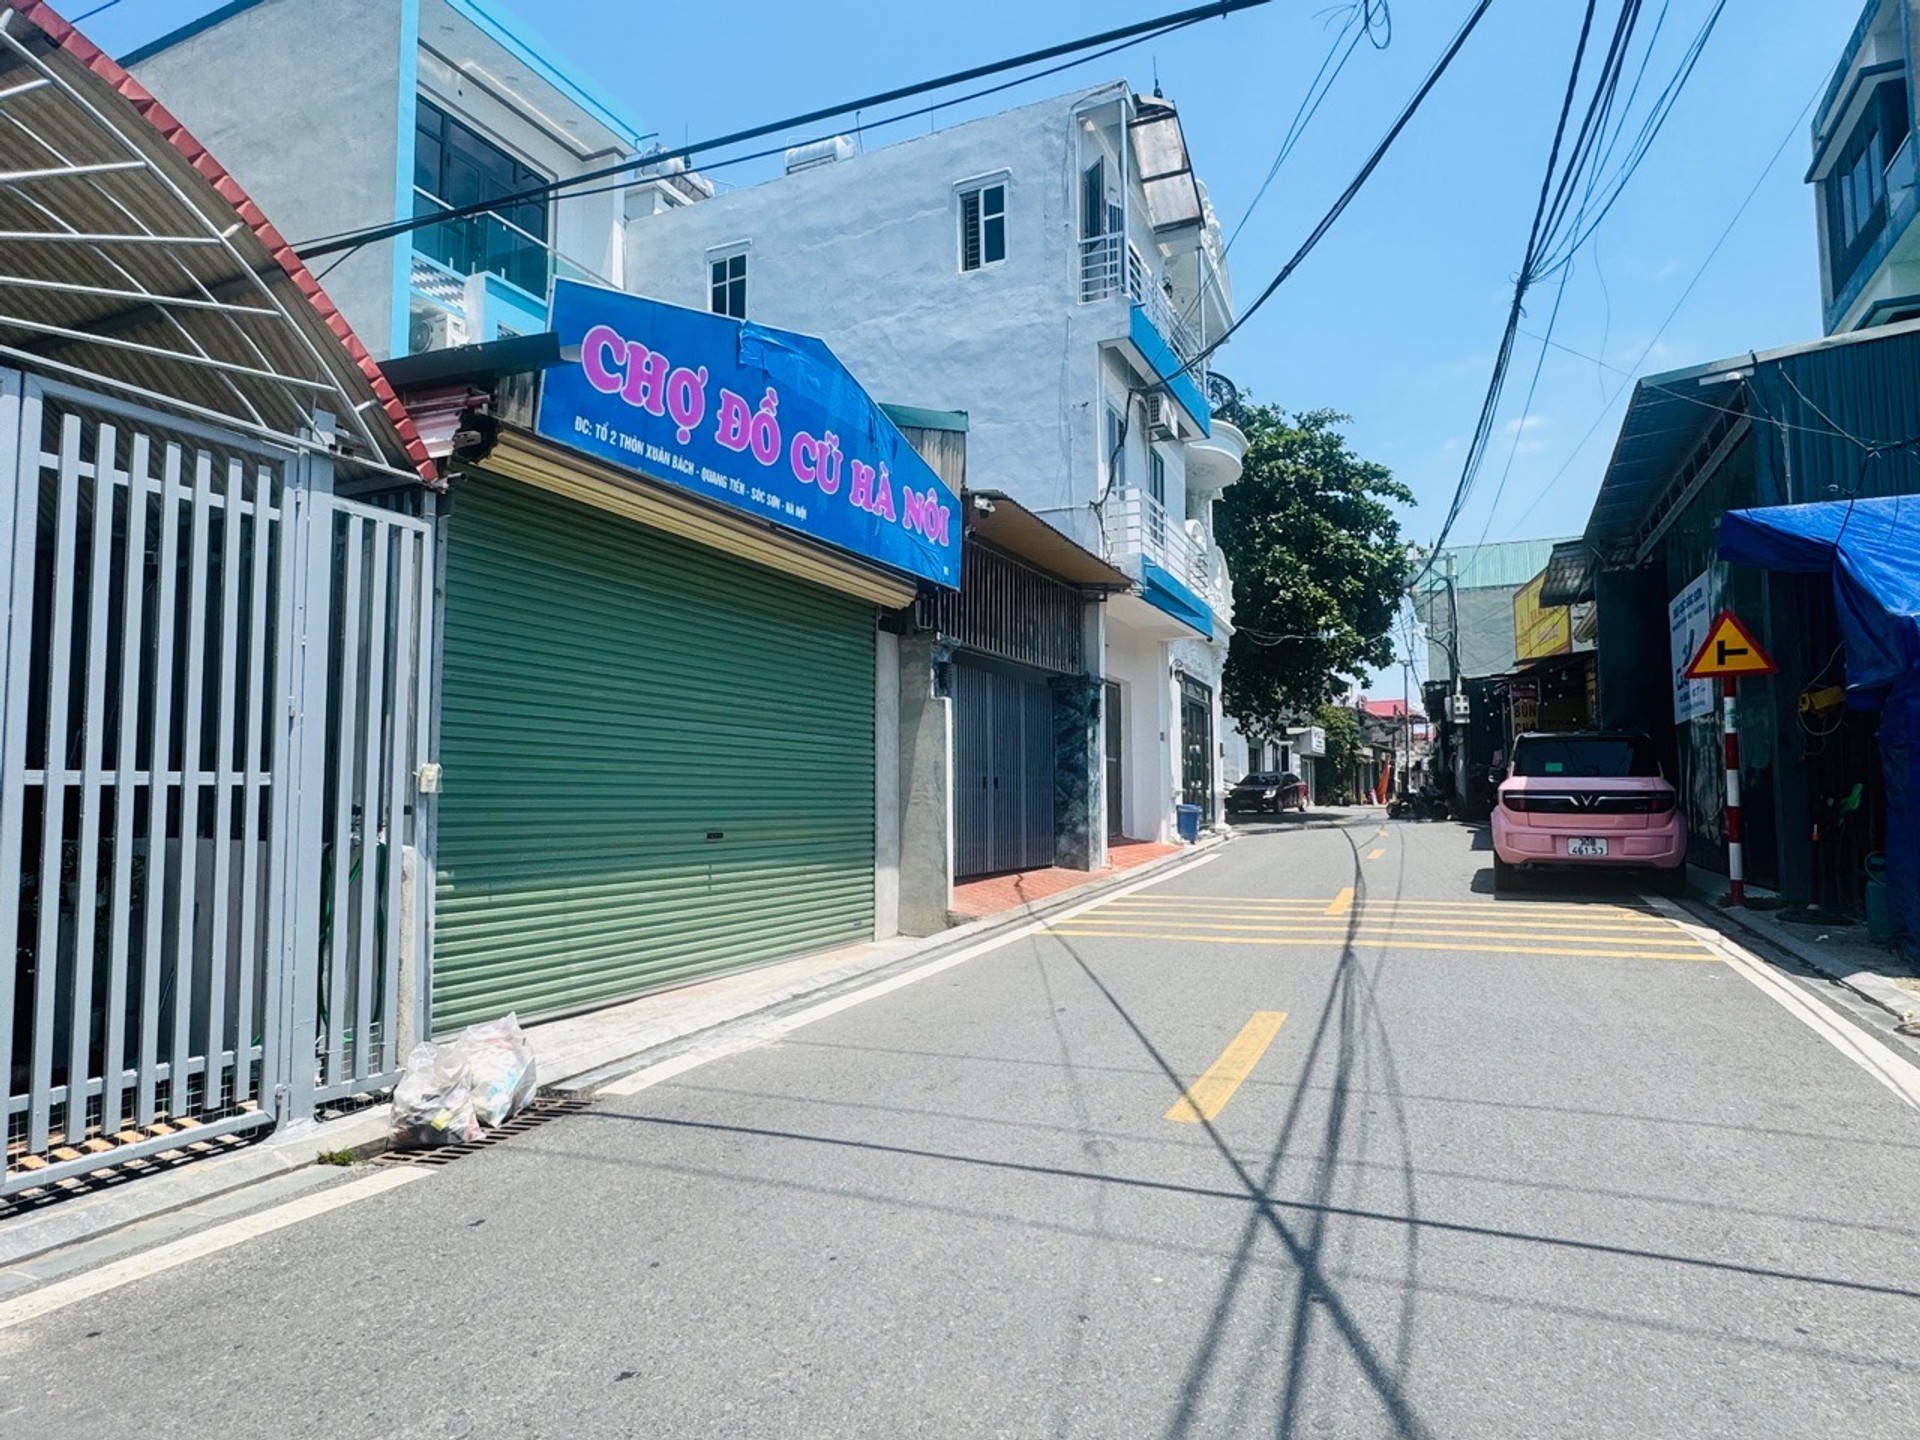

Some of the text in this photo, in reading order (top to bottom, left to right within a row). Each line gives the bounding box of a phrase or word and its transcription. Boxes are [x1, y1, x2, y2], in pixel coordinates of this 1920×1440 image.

[581, 324, 950, 547] CHỢ ĐỒ CŨ HÀ NỘI
[610, 430, 617, 446] 2
[645, 443, 671, 466] XUÂN
[701, 466, 728, 489] QUANG
